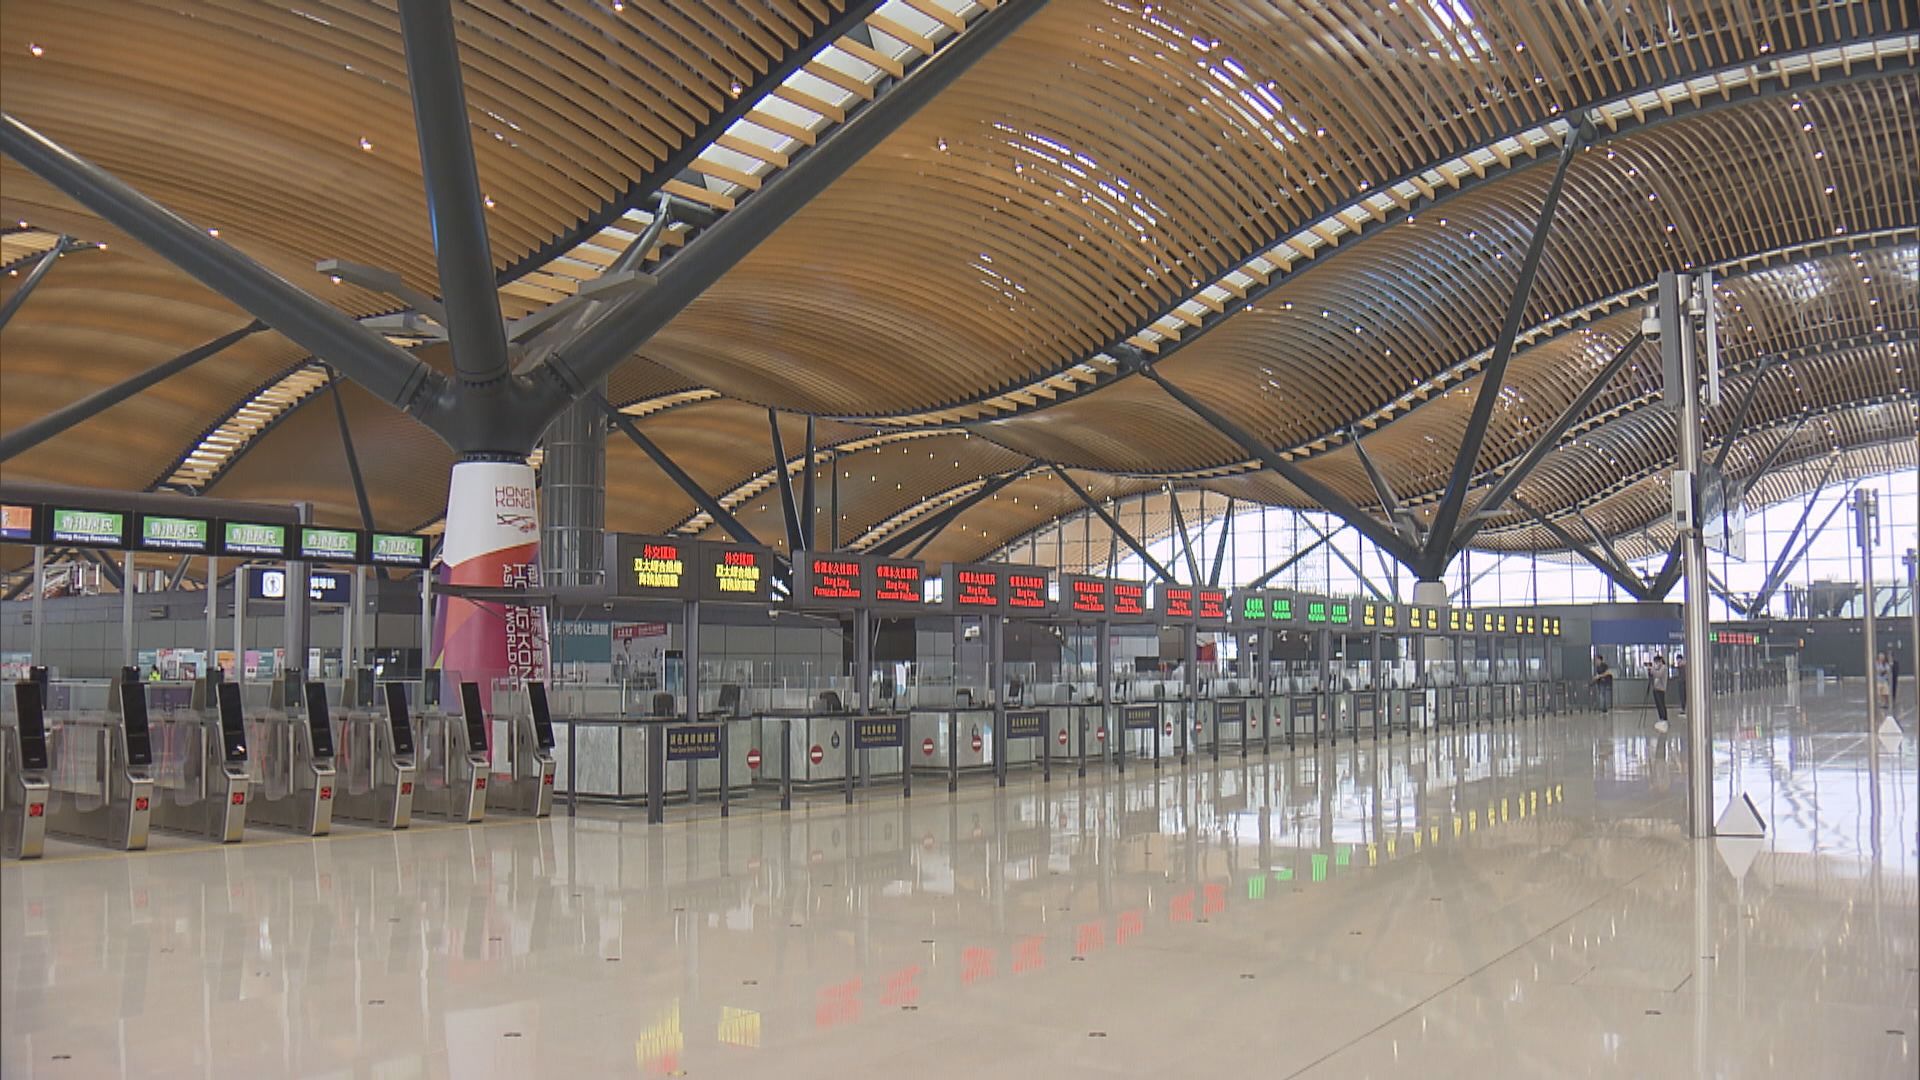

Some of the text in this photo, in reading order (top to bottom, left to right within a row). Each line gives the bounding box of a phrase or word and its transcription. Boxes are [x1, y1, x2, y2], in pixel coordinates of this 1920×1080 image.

[495, 486, 531, 498] HONG
[496, 498, 531, 509] KONG
[505, 611, 517, 662] WORLD
